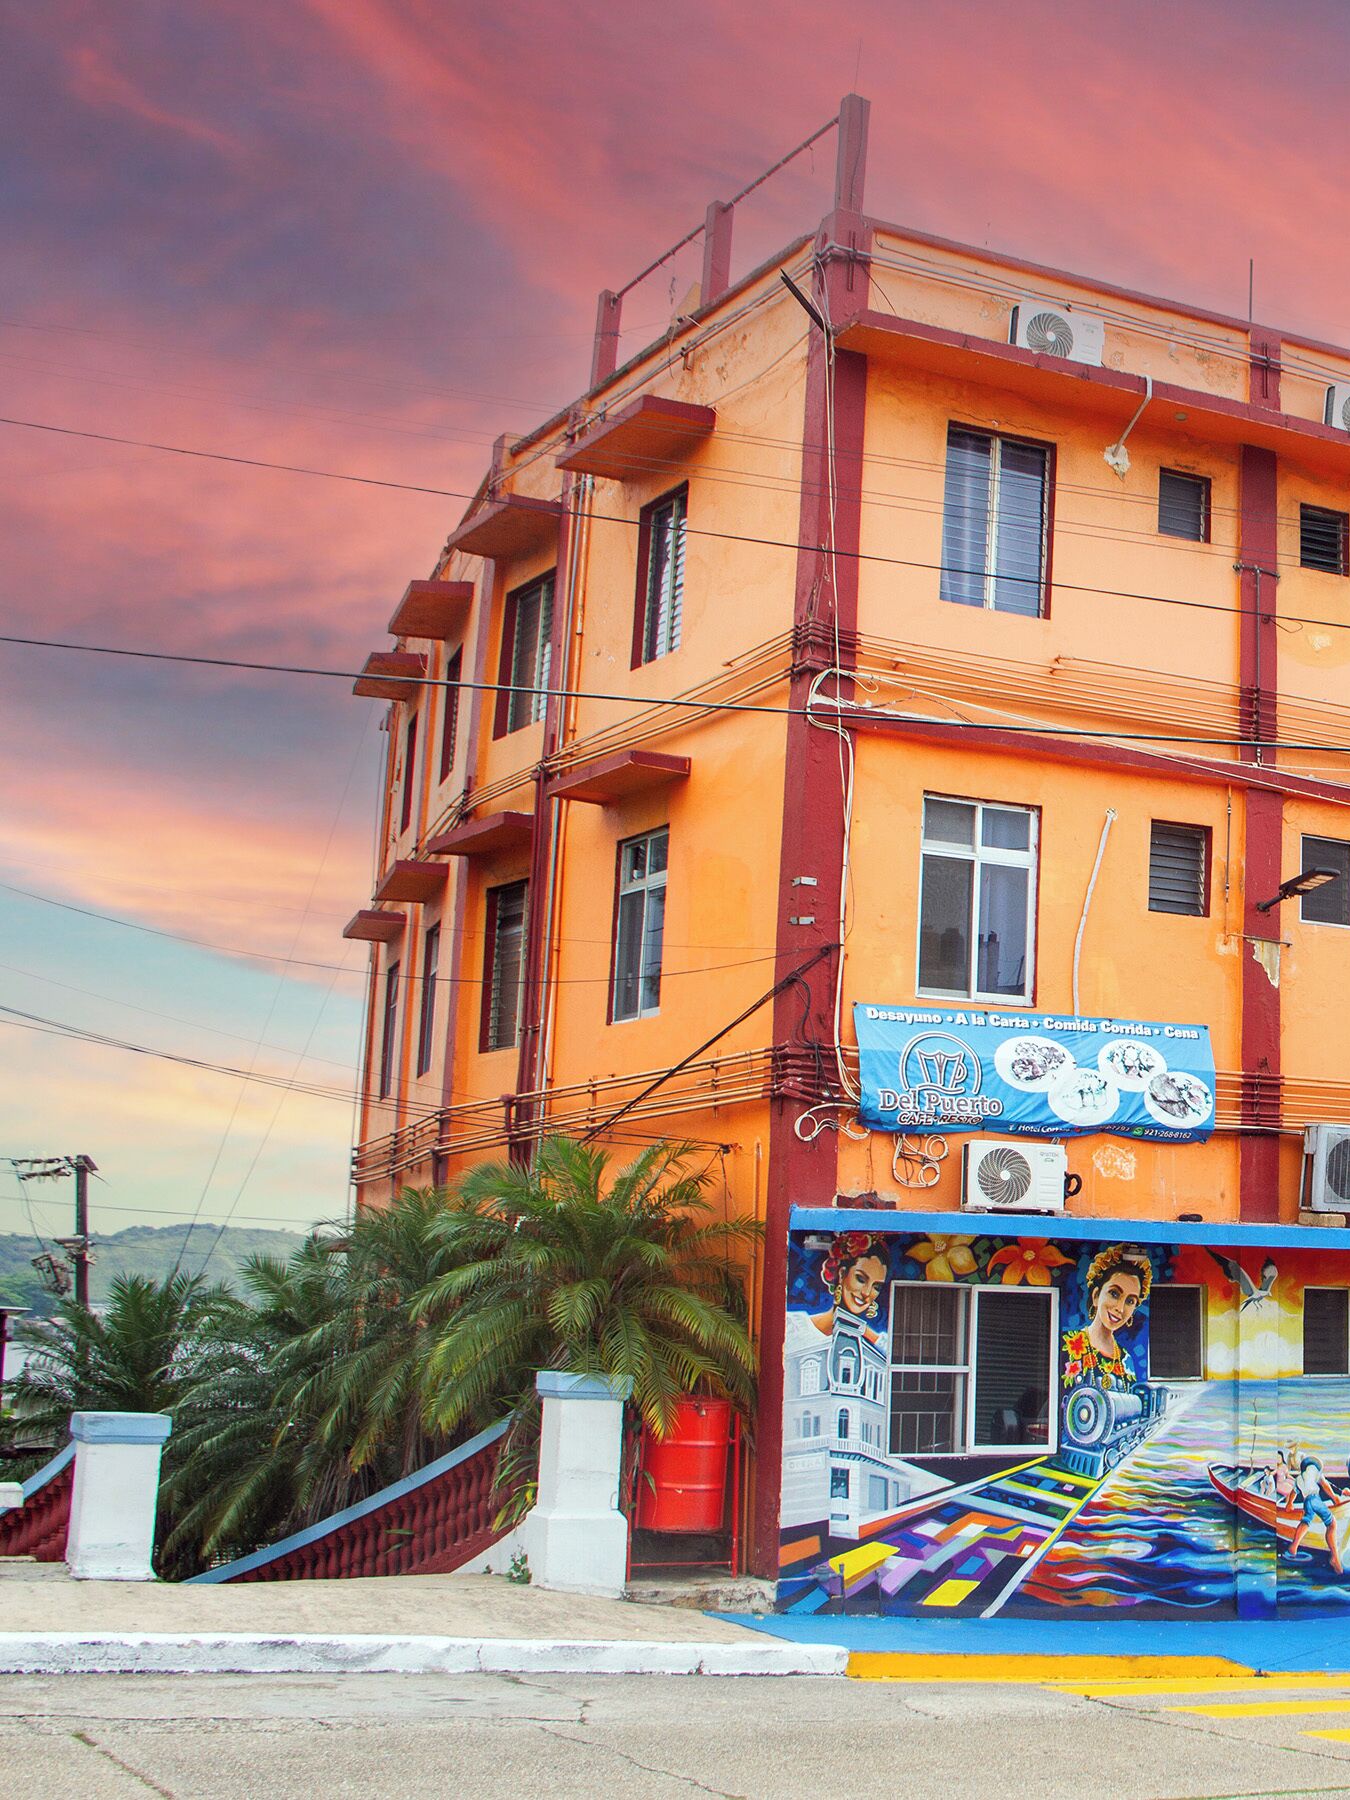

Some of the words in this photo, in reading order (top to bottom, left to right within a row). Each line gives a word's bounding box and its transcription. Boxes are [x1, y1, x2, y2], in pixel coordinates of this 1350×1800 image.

[866, 1007, 943, 1025] Desayuno
[955, 1013, 969, 1025] A
[971, 1014, 986, 1026] la
[989, 1015, 1030, 1028] Carta
[1043, 1017, 1097, 1032] Comida
[1100, 1021, 1152, 1036] Corrida
[1164, 1026, 1199, 1040] Cena
[879, 1088, 920, 1112] Del
[926, 1091, 1003, 1116] Puerto
